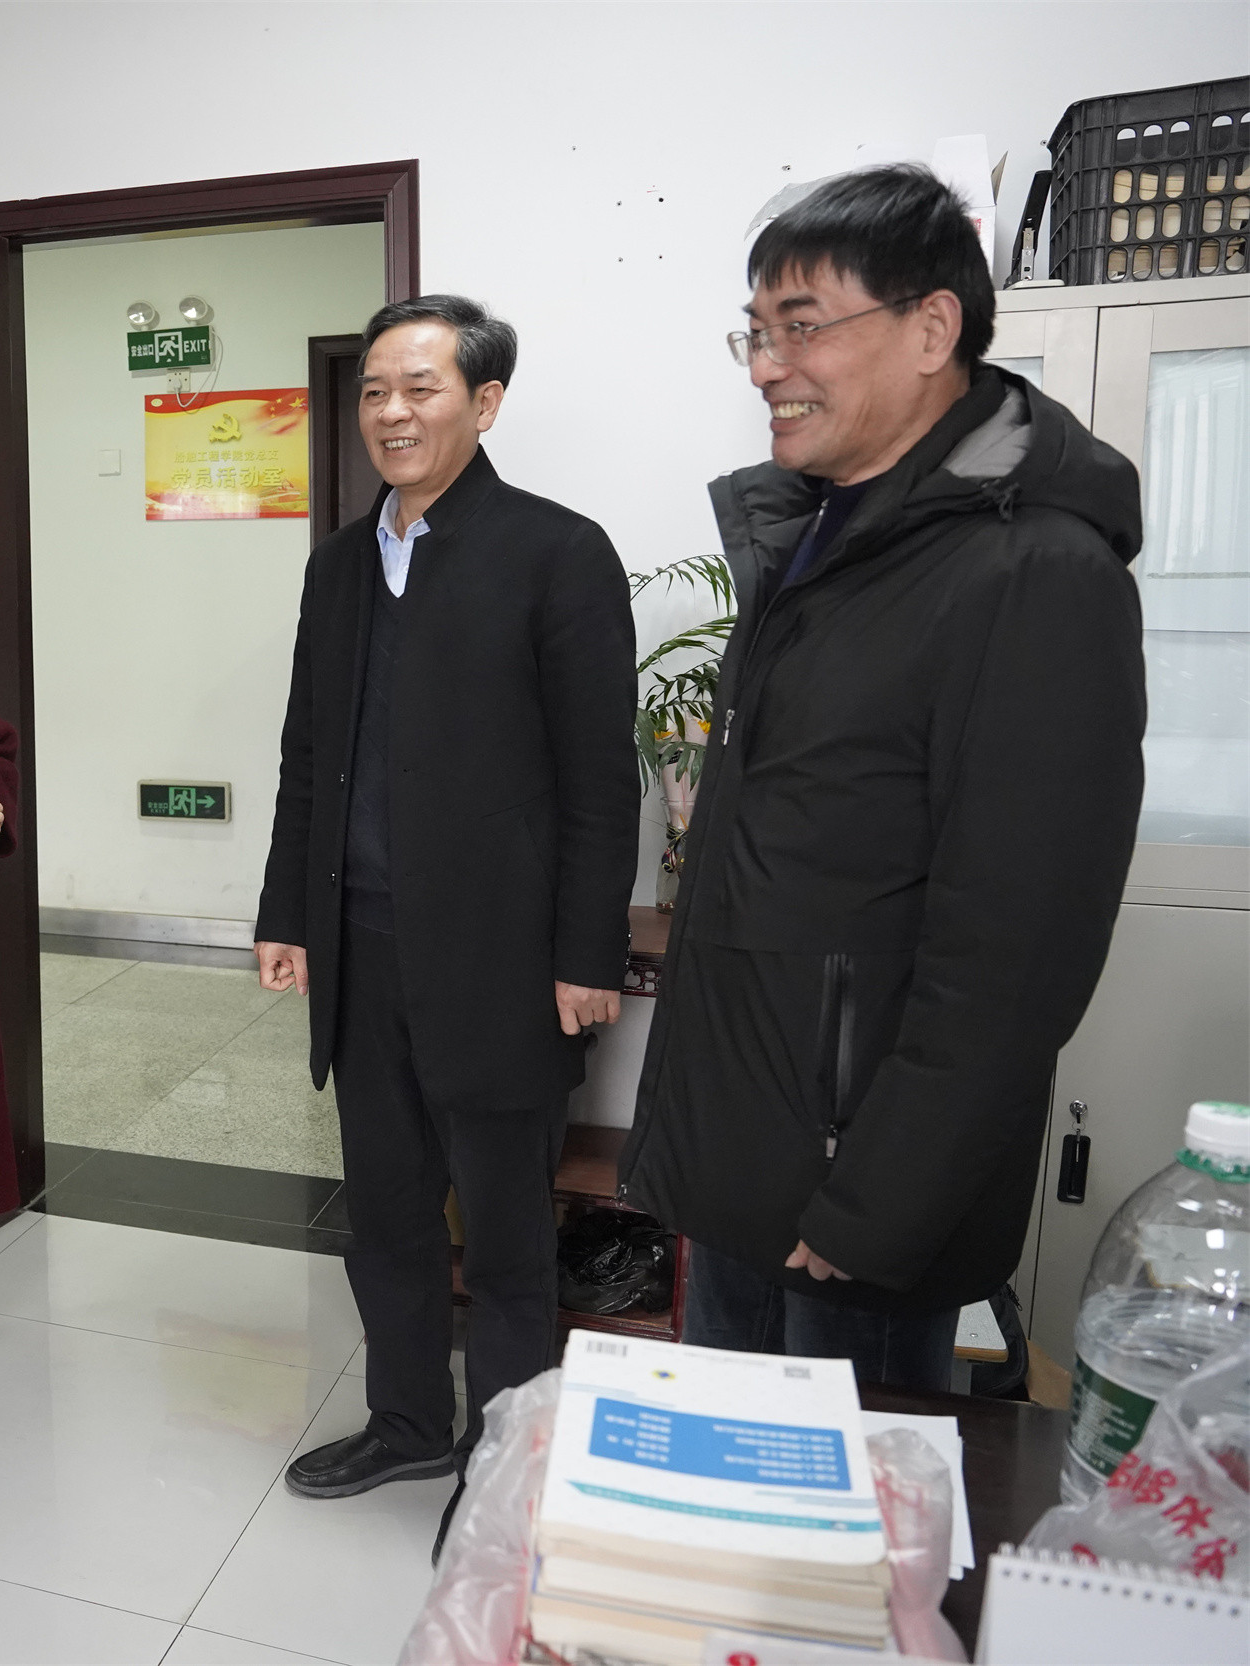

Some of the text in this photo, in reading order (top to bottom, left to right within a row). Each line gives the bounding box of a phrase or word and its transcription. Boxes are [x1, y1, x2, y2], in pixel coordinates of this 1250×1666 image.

[131, 344, 154, 357] 安全出口
[184, 339, 207, 353] EXIT
[171, 466, 285, 489] 党员活动室
